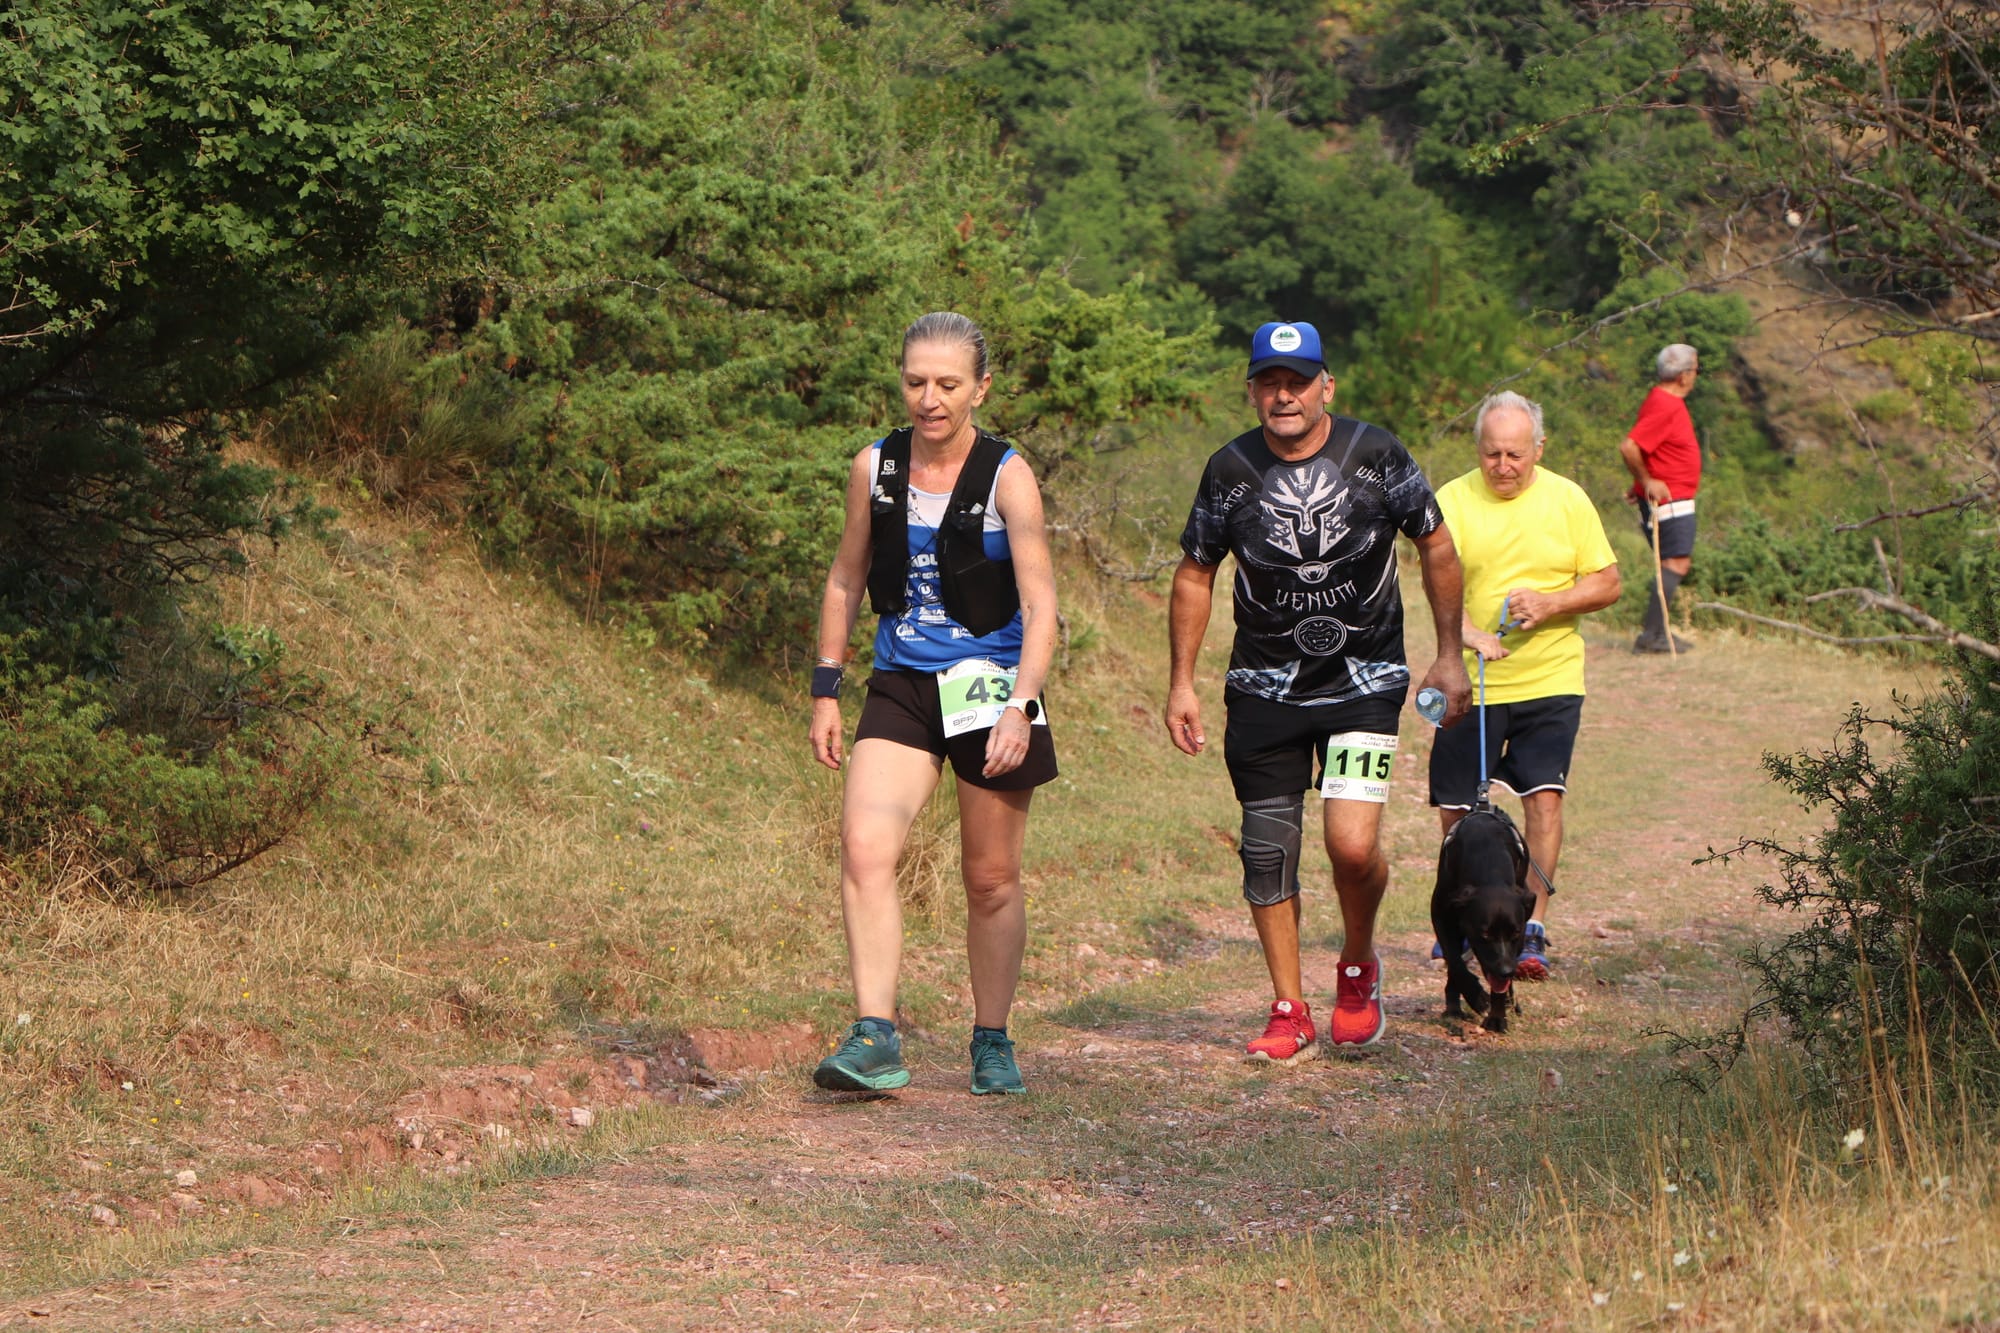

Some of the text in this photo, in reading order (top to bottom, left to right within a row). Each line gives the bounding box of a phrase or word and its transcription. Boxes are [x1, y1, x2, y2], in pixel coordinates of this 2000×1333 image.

[1276, 580, 1358, 612] VENUM
[965, 676, 1014, 704] 43
[1335, 749, 1391, 780] 115
